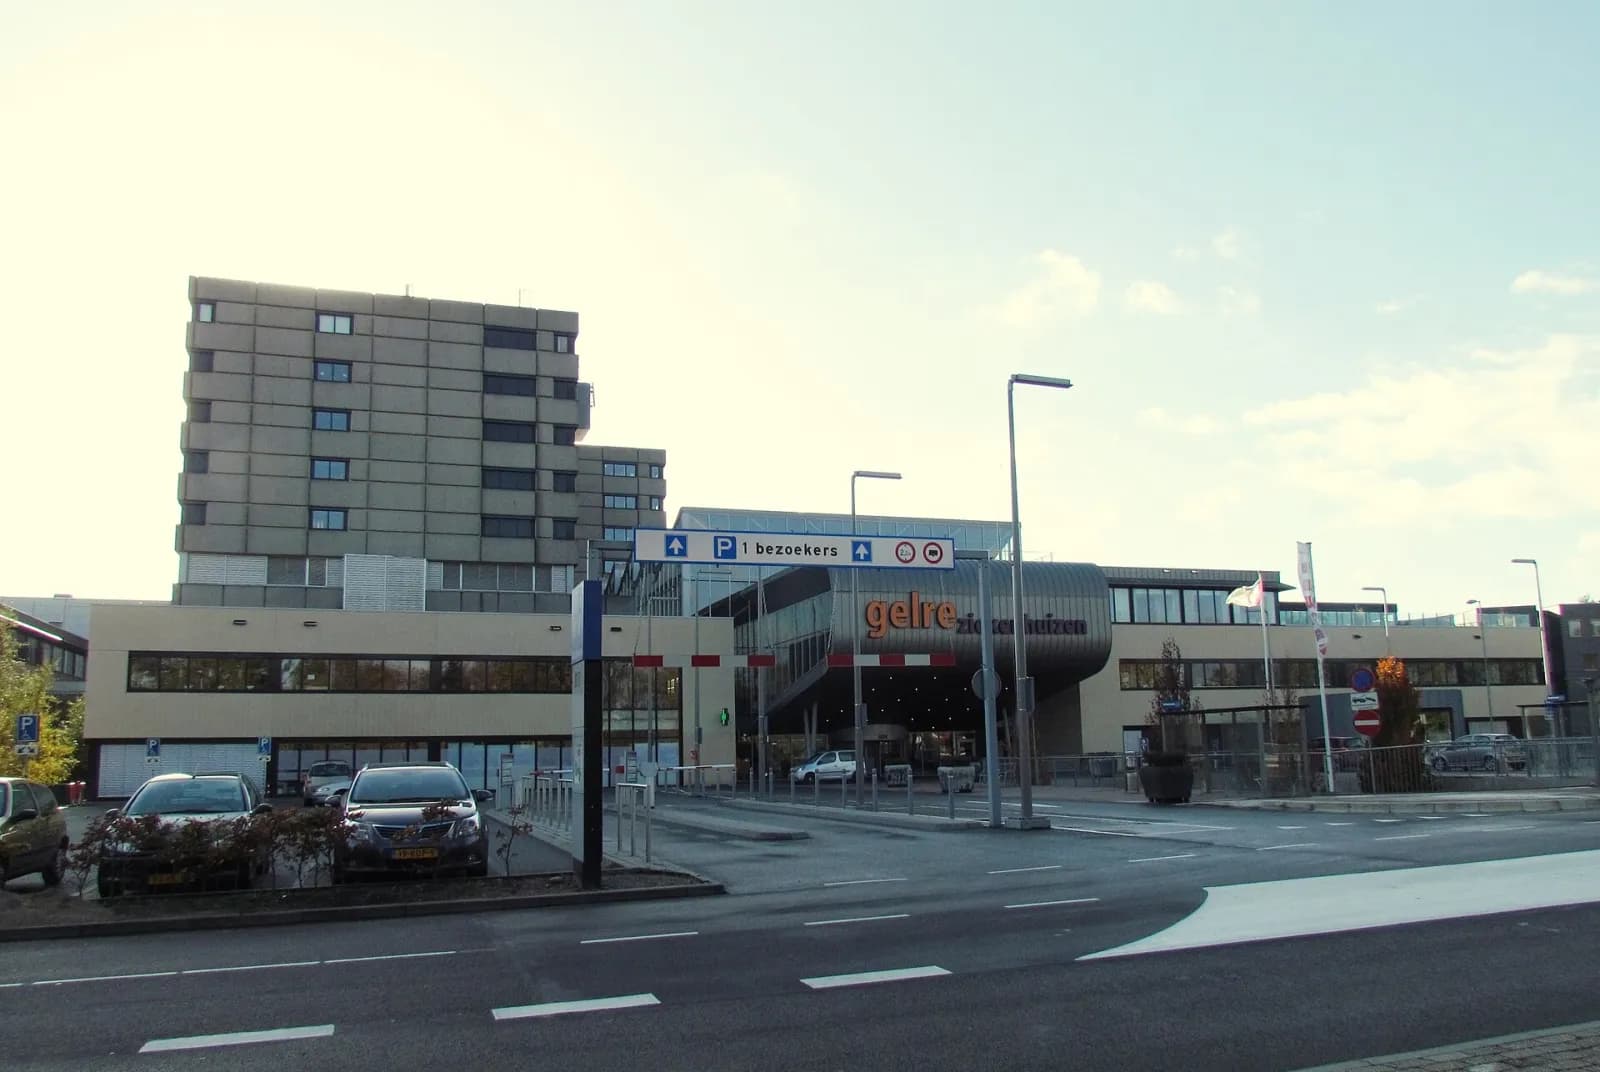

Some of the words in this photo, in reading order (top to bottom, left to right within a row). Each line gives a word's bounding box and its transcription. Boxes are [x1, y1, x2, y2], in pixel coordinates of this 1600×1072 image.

[717, 537, 732, 557] P
[742, 541, 748, 554] 1
[756, 542, 838, 557] bezoekers
[866, 591, 957, 639] gelre
[21, 716, 33, 730] P
[149, 739, 157, 748] P
[261, 738, 269, 747] P
